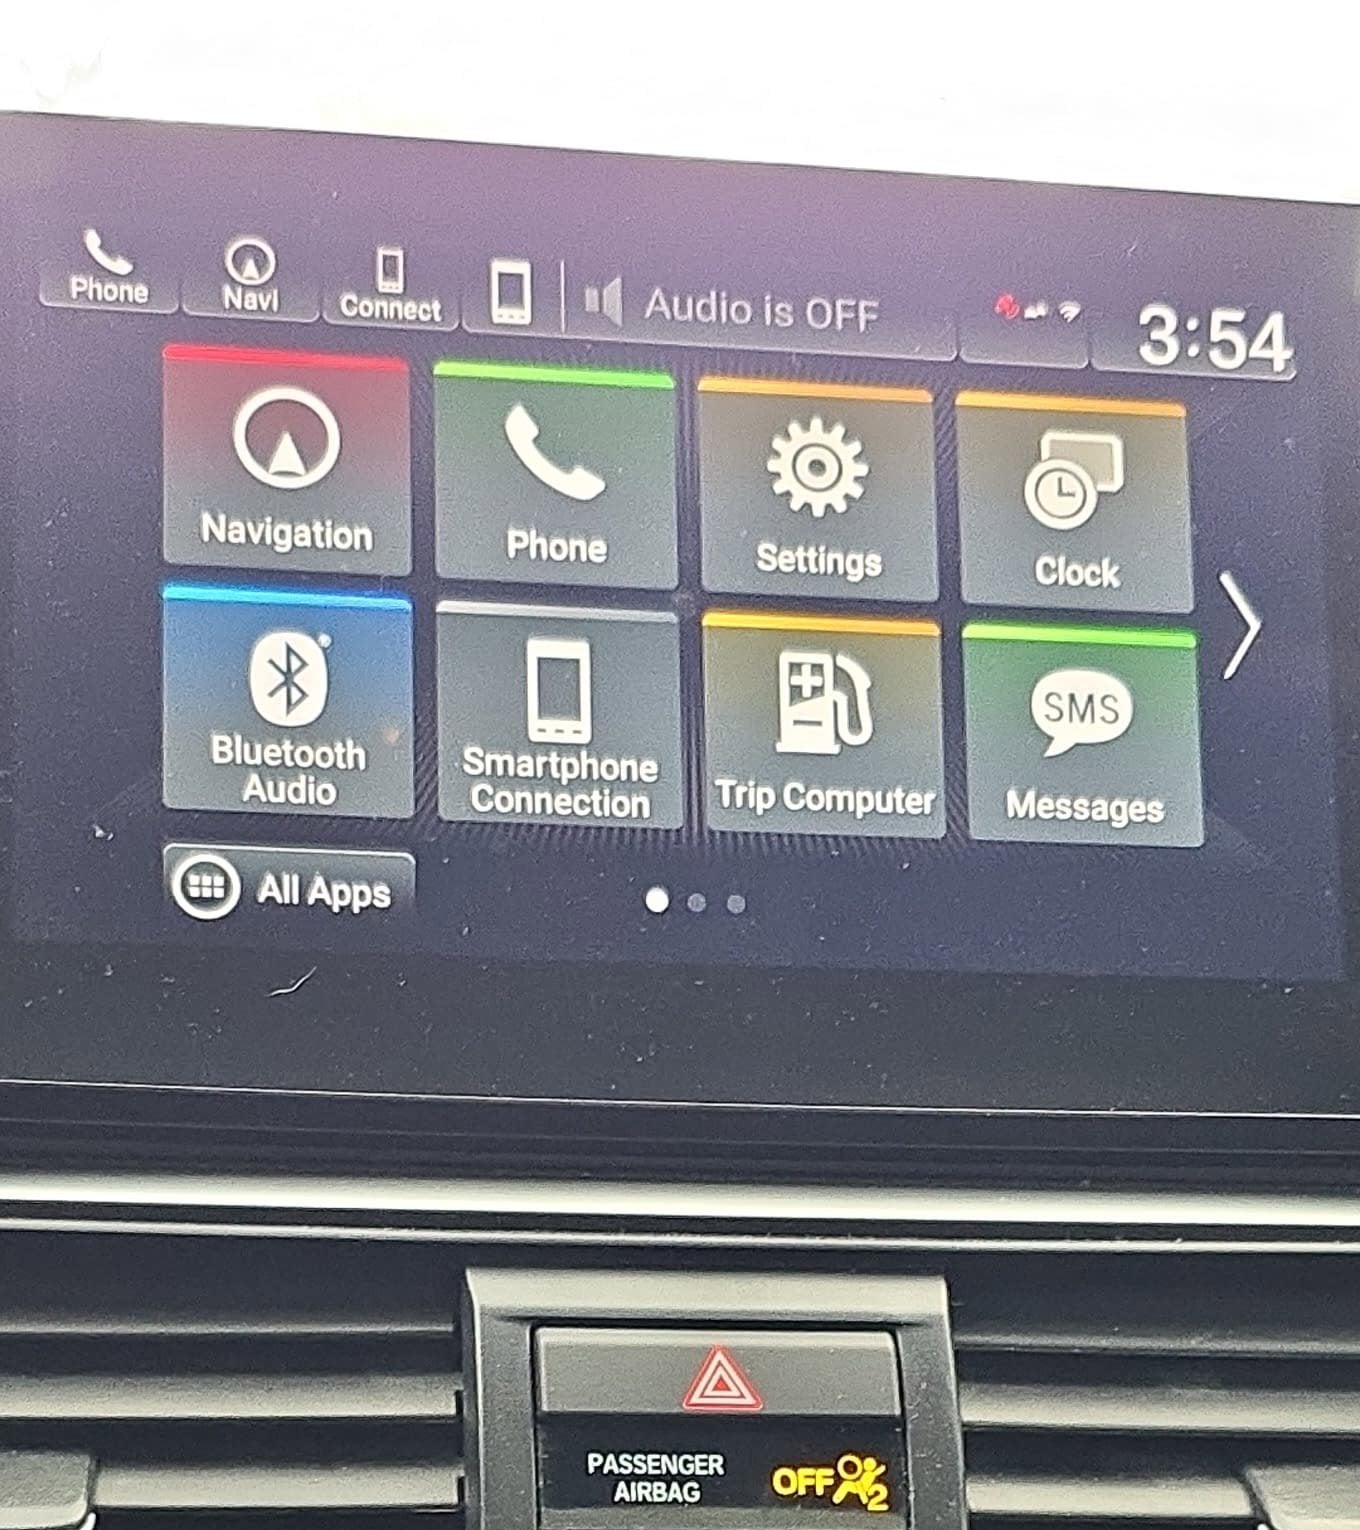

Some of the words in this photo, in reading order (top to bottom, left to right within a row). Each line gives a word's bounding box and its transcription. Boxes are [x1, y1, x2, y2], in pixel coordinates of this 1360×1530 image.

[70, 274, 149, 305] Phone
[223, 284, 280, 314] Navi
[340, 294, 442, 323] Connect
[643, 286, 753, 326] Audio
[763, 292, 795, 328] is
[804, 297, 880, 334] OFF
[1138, 302, 1295, 374] 3:54
[201, 510, 373, 555] Navigation
[506, 528, 608, 565] Phone
[756, 542, 883, 584] Settings
[1034, 555, 1122, 589] Clock
[1043, 691, 1121, 726] SMS
[210, 734, 367, 772] Bluetooth
[462, 748, 659, 786] Smartphone
[241, 774, 337, 807] Audio
[470, 784, 652, 820] Connection
[715, 778, 776, 815] Trip
[782, 782, 937, 819] Computer
[1006, 786, 1166, 829] Messages
[258, 872, 300, 905] All
[308, 872, 392, 911] Apps
[587, 1453, 725, 1477] PASSENGER
[772, 1467, 836, 1497] OFF
[614, 1481, 701, 1503] AIRBAG
